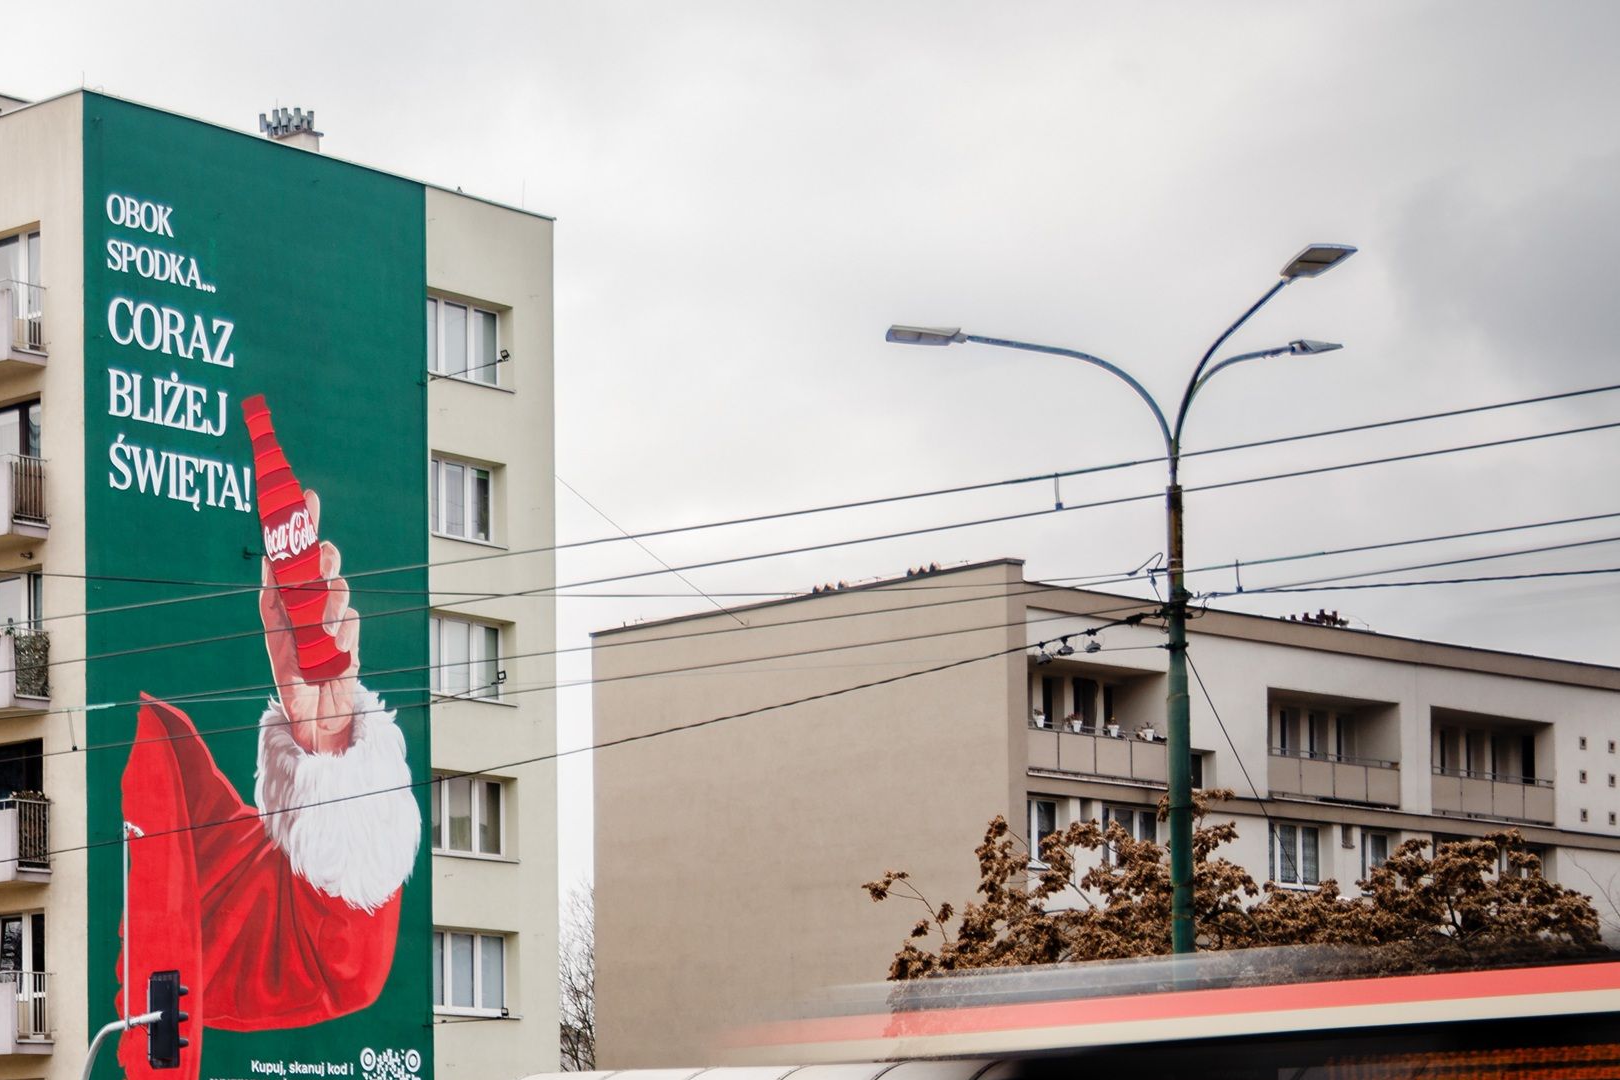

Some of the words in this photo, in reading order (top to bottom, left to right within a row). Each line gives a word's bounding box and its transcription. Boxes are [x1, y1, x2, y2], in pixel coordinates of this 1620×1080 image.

[106, 193, 174, 238] OBOK
[106, 239, 216, 293] SPODKA...
[107, 297, 234, 367] CORAZ
[108, 367, 228, 436] BLIŻEJ
[109, 434, 251, 513] ŚWIĘTA!
[251, 1060, 286, 1075] Kupuj,
[289, 1061, 325, 1076] skanuj
[327, 1063, 347, 1075] kod
